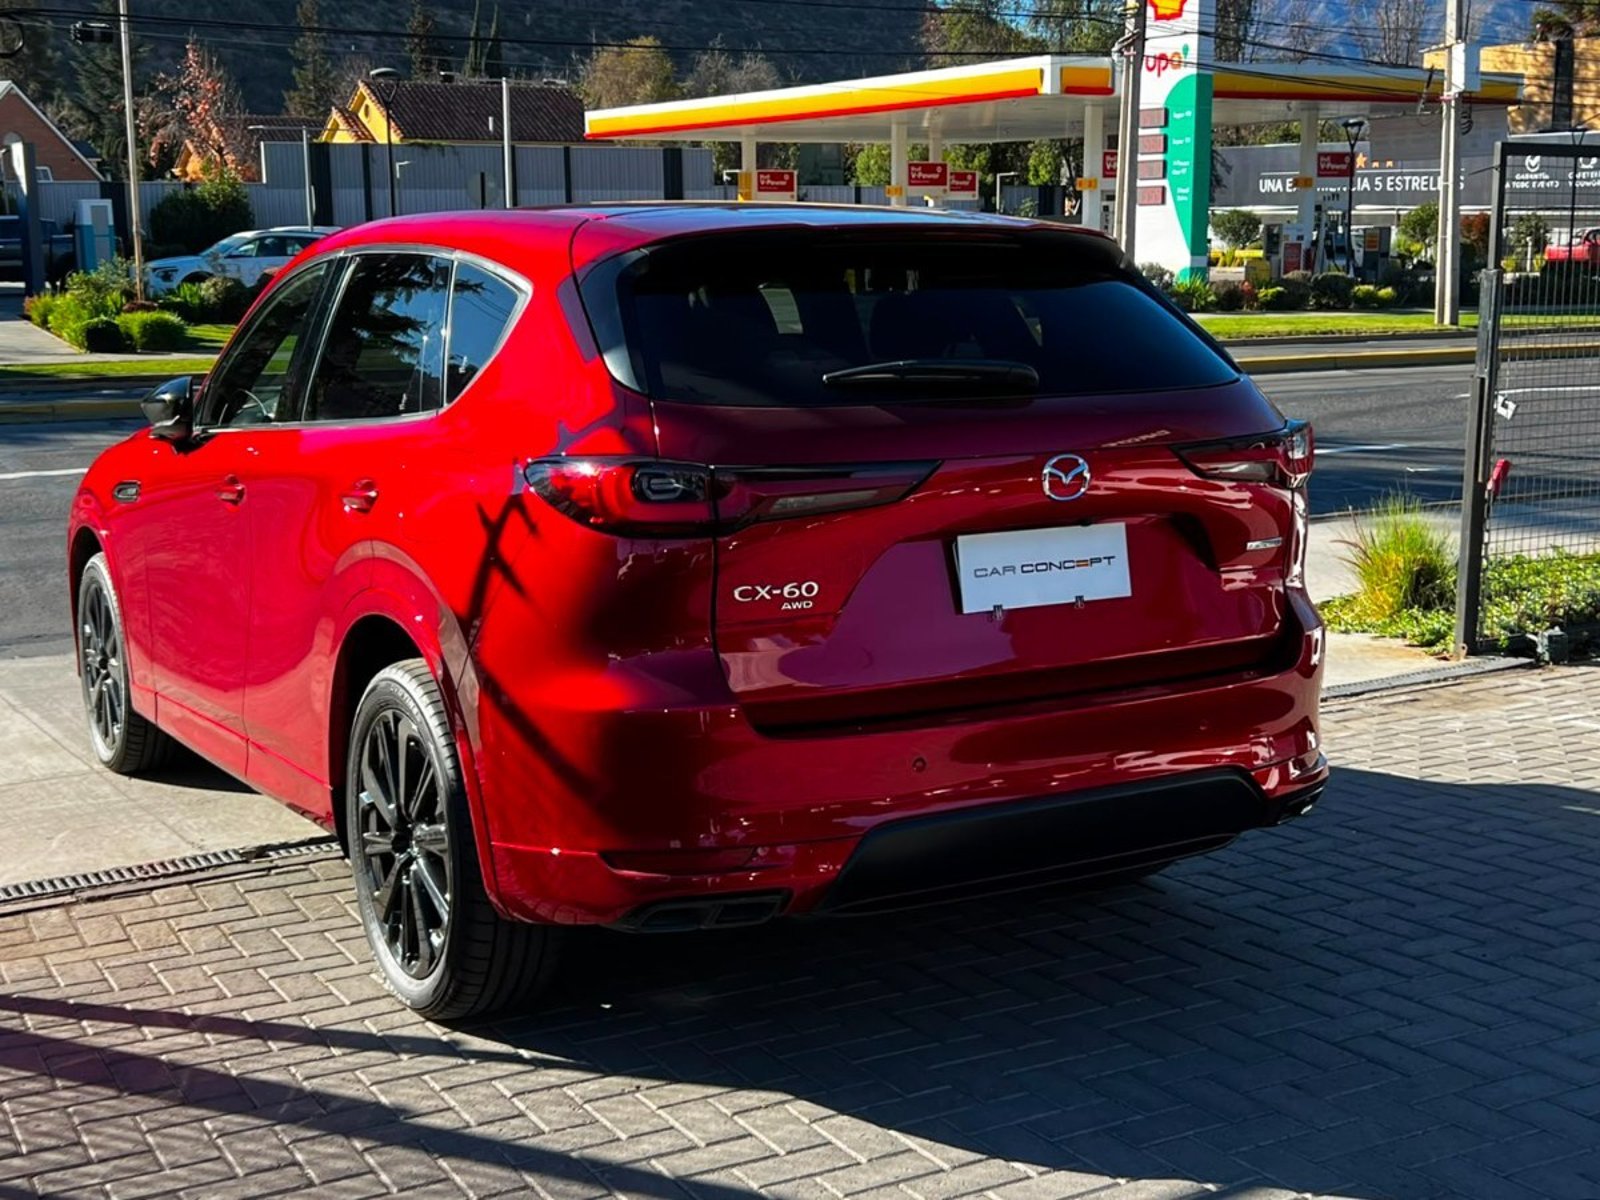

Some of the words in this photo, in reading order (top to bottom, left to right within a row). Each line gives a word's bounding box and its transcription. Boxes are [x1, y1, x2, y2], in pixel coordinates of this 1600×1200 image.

[1259, 178, 1284, 193] UNA
[1374, 176, 1383, 191] 5
[973, 565, 1017, 578] CAR
[1020, 555, 1116, 574] CONCEPT
[733, 581, 819, 602] CX-60
[781, 600, 813, 611] AWD
